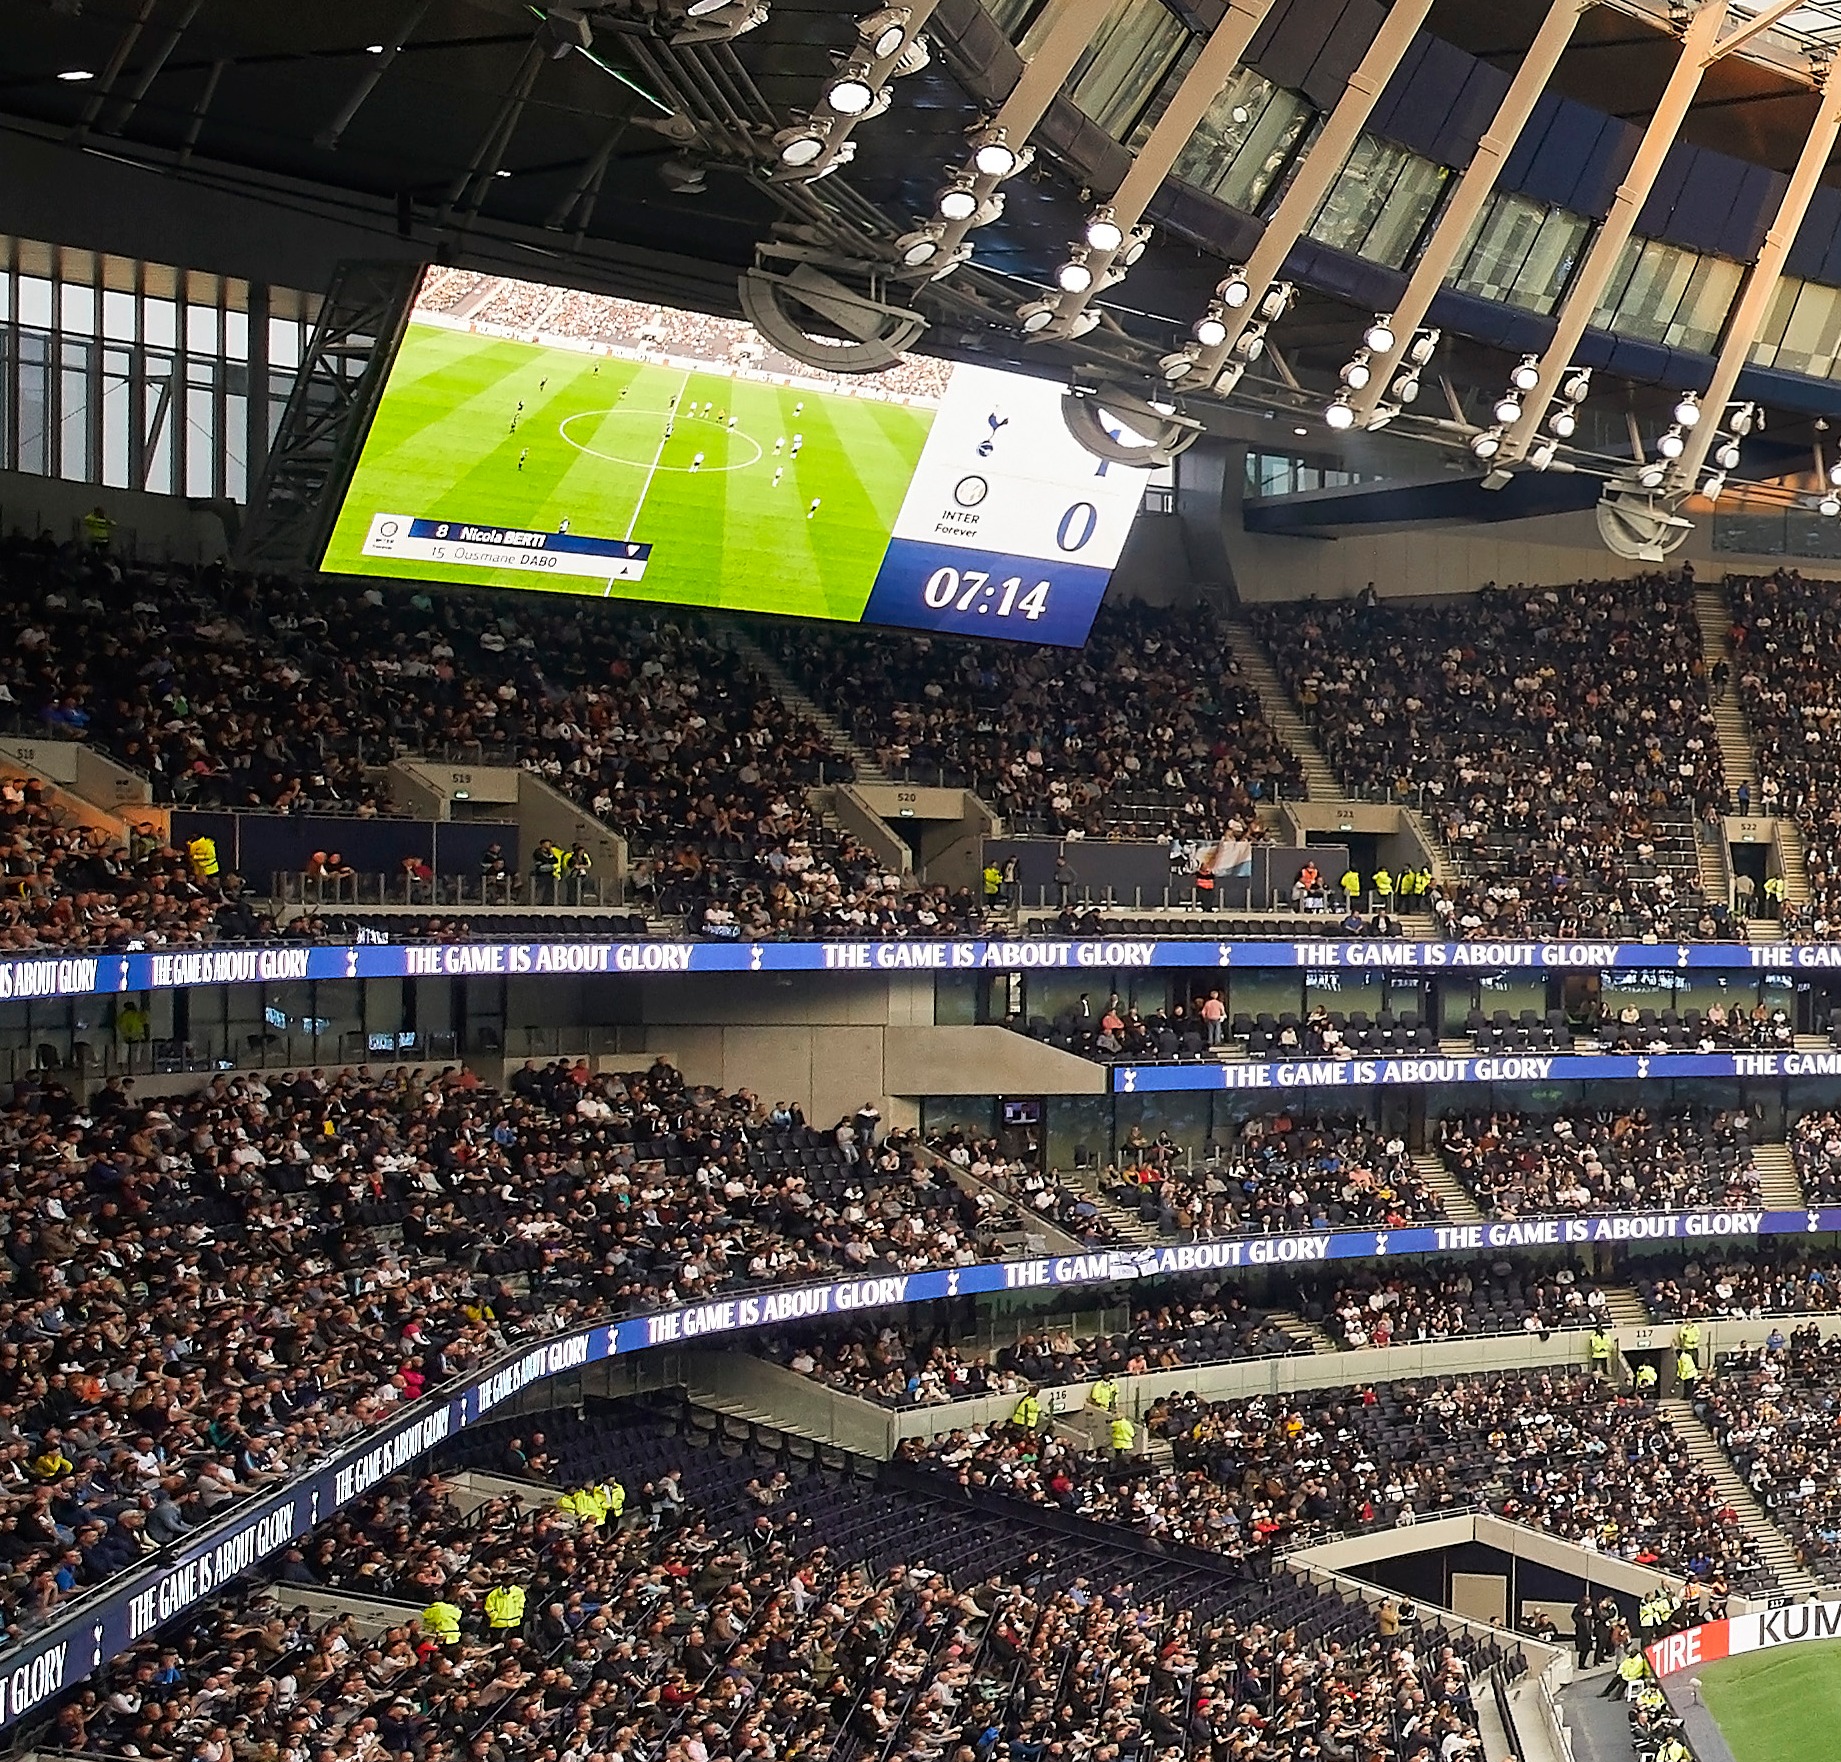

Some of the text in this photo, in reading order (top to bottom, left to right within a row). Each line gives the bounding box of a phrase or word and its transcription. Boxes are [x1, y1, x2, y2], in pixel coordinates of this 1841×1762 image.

[942, 510, 980, 525] INTER
[1056, 502, 1098, 552] 0
[436, 524, 547, 549] 8 Nicola BERTI
[934, 523, 978, 539] Forever
[431, 547, 558, 569] 15 Ousmane DABO
[923, 567, 1051, 621] 07:14
[452, 774, 471, 784] 519
[897, 793, 916, 802] 520
[1336, 810, 1354, 819] 521
[1741, 823, 1757, 831] 522
[406, 944, 695, 973] THE GAME IS ABOUT GLORY
[823, 942, 1156, 968] THE GAME IS ABOUT GLORY
[1294, 944, 1618, 966] THE GAME IS ABOUT GLORY
[1748, 945, 1793, 966] THE
[1222, 1057, 1552, 1087] THE GAME IS ABOUT GLORY
[1732, 1055, 1778, 1075] THE
[1434, 1213, 1762, 1249] THE GAME IS ABOUT GLORY
[650, 1276, 910, 1344] THE GAME IS ABOUT GLORY
[1636, 1329, 1653, 1338] 117
[1050, 1391, 1067, 1401] 116
[1652, 1626, 1702, 1679] TIRE
